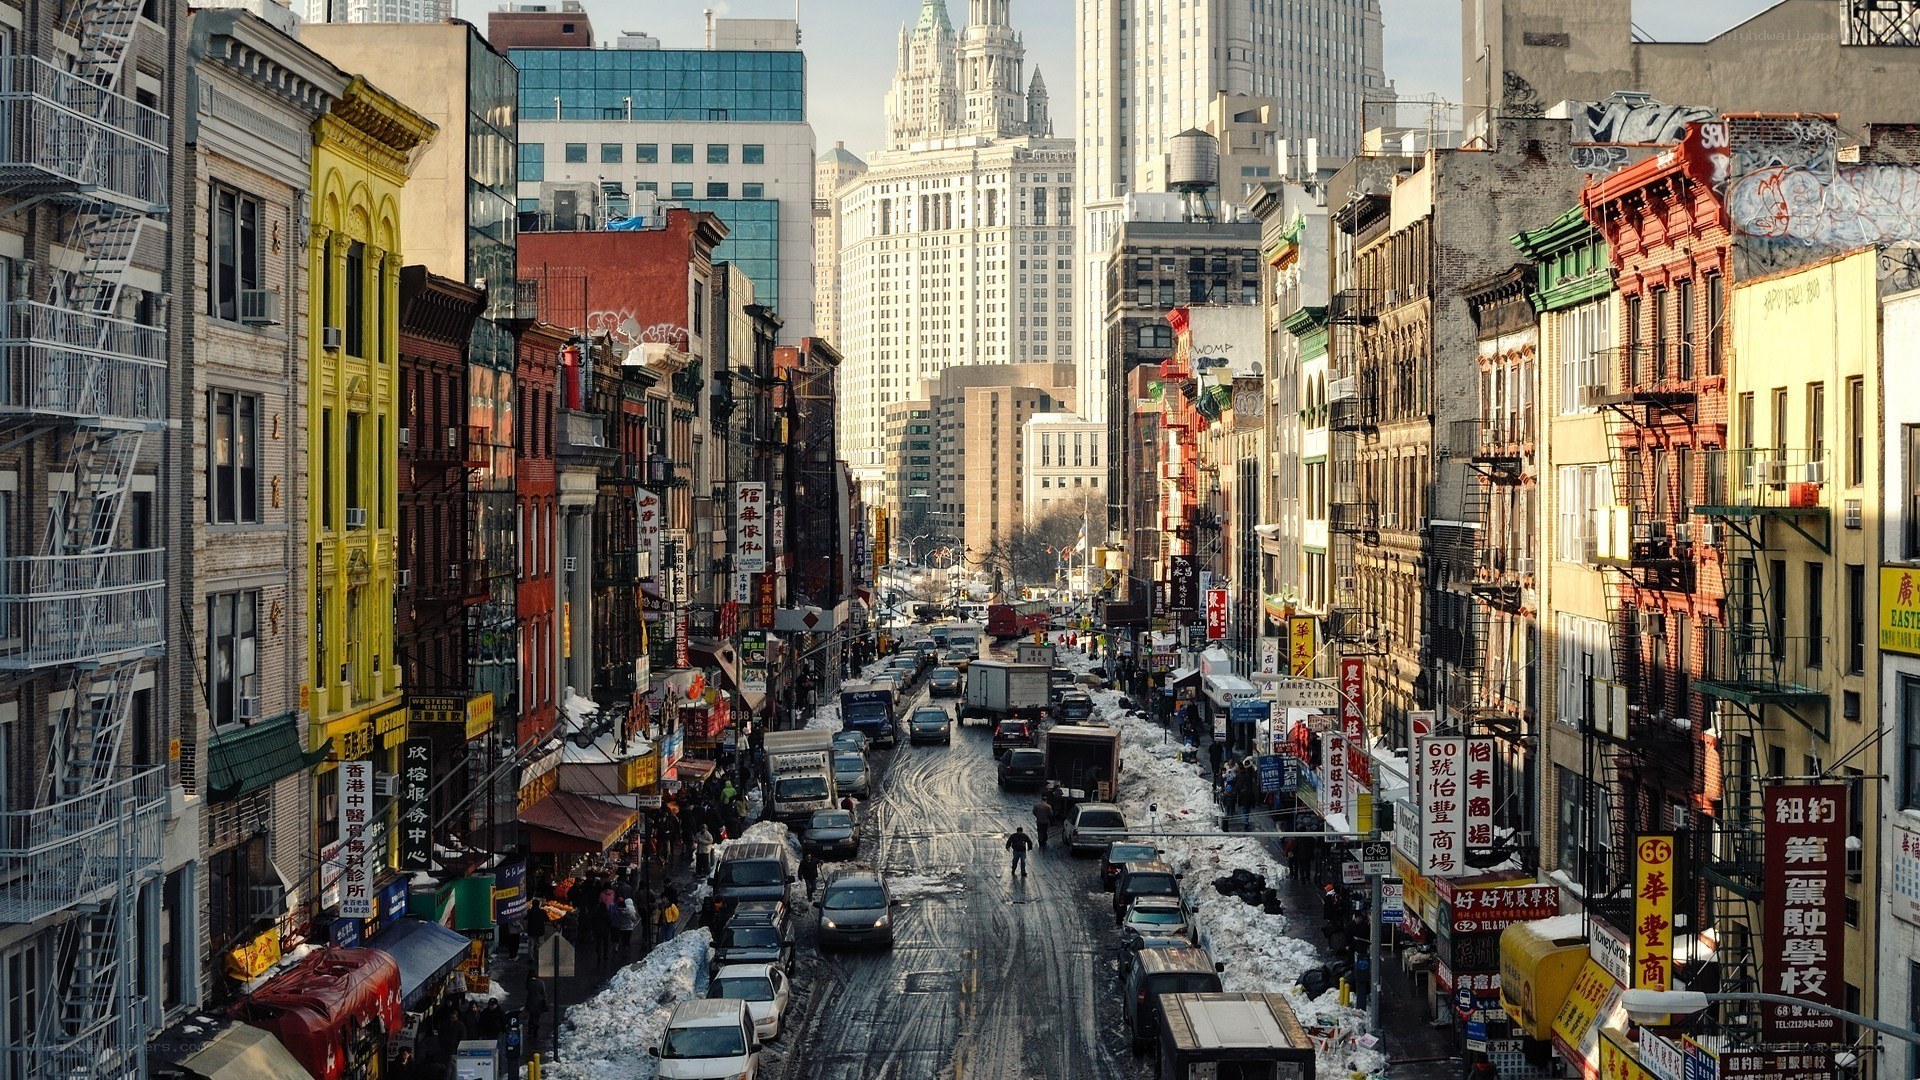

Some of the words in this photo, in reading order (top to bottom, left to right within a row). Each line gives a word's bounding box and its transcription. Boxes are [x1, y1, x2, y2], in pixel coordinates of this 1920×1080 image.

[1897, 572, 1920, 607] 廣
[412, 712, 461, 721] 西聯匯款
[1776, 797, 1836, 823] 紐約
[1642, 842, 1668, 862] 66
[1459, 922, 1473, 930] 62
[1481, 921, 1492, 930] TEL
[1493, 921, 1498, 930] &
[1780, 837, 1828, 996] 第一駕駛學校
[1777, 1006, 1788, 1015] 68
